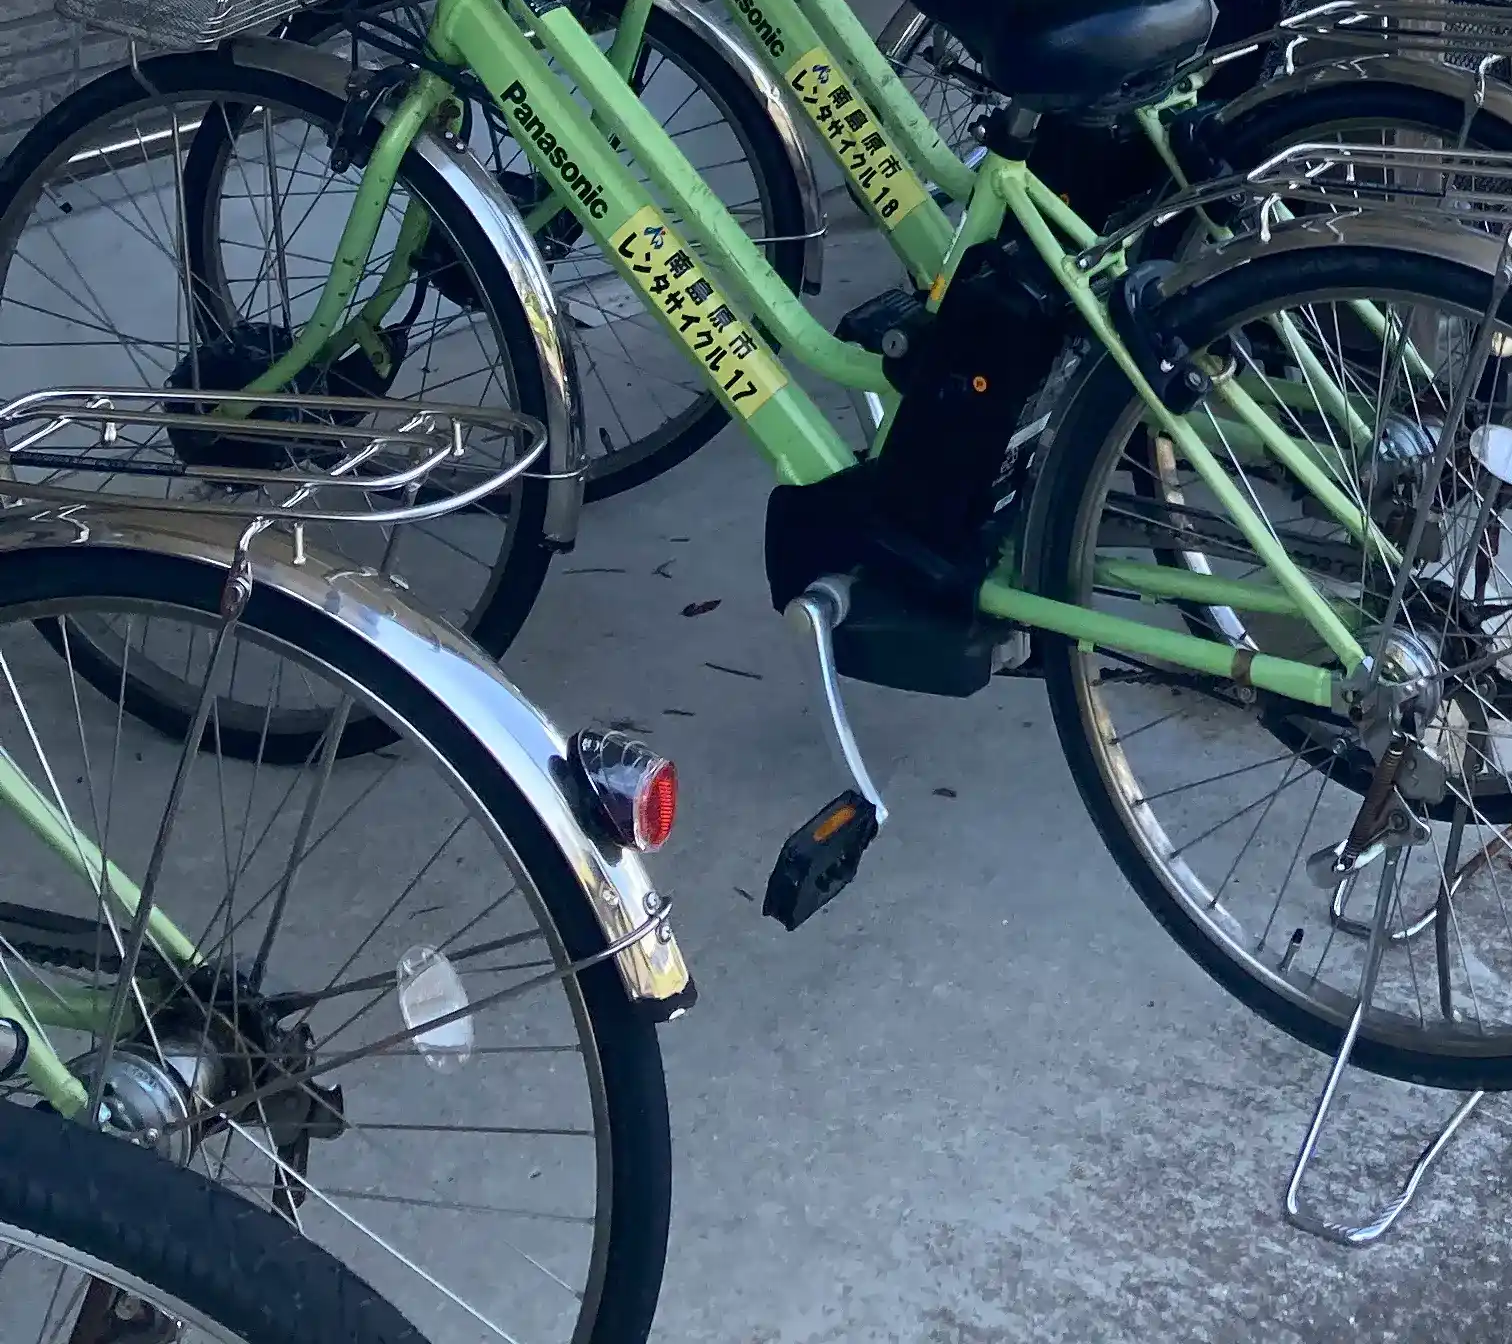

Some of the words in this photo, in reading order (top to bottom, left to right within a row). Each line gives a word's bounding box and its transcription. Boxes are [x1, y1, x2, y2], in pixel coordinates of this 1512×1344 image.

[499, 79, 610, 222] Panasonic
[827, 84, 904, 180] 南島原市
[663, 250, 758, 361] 南島原市
